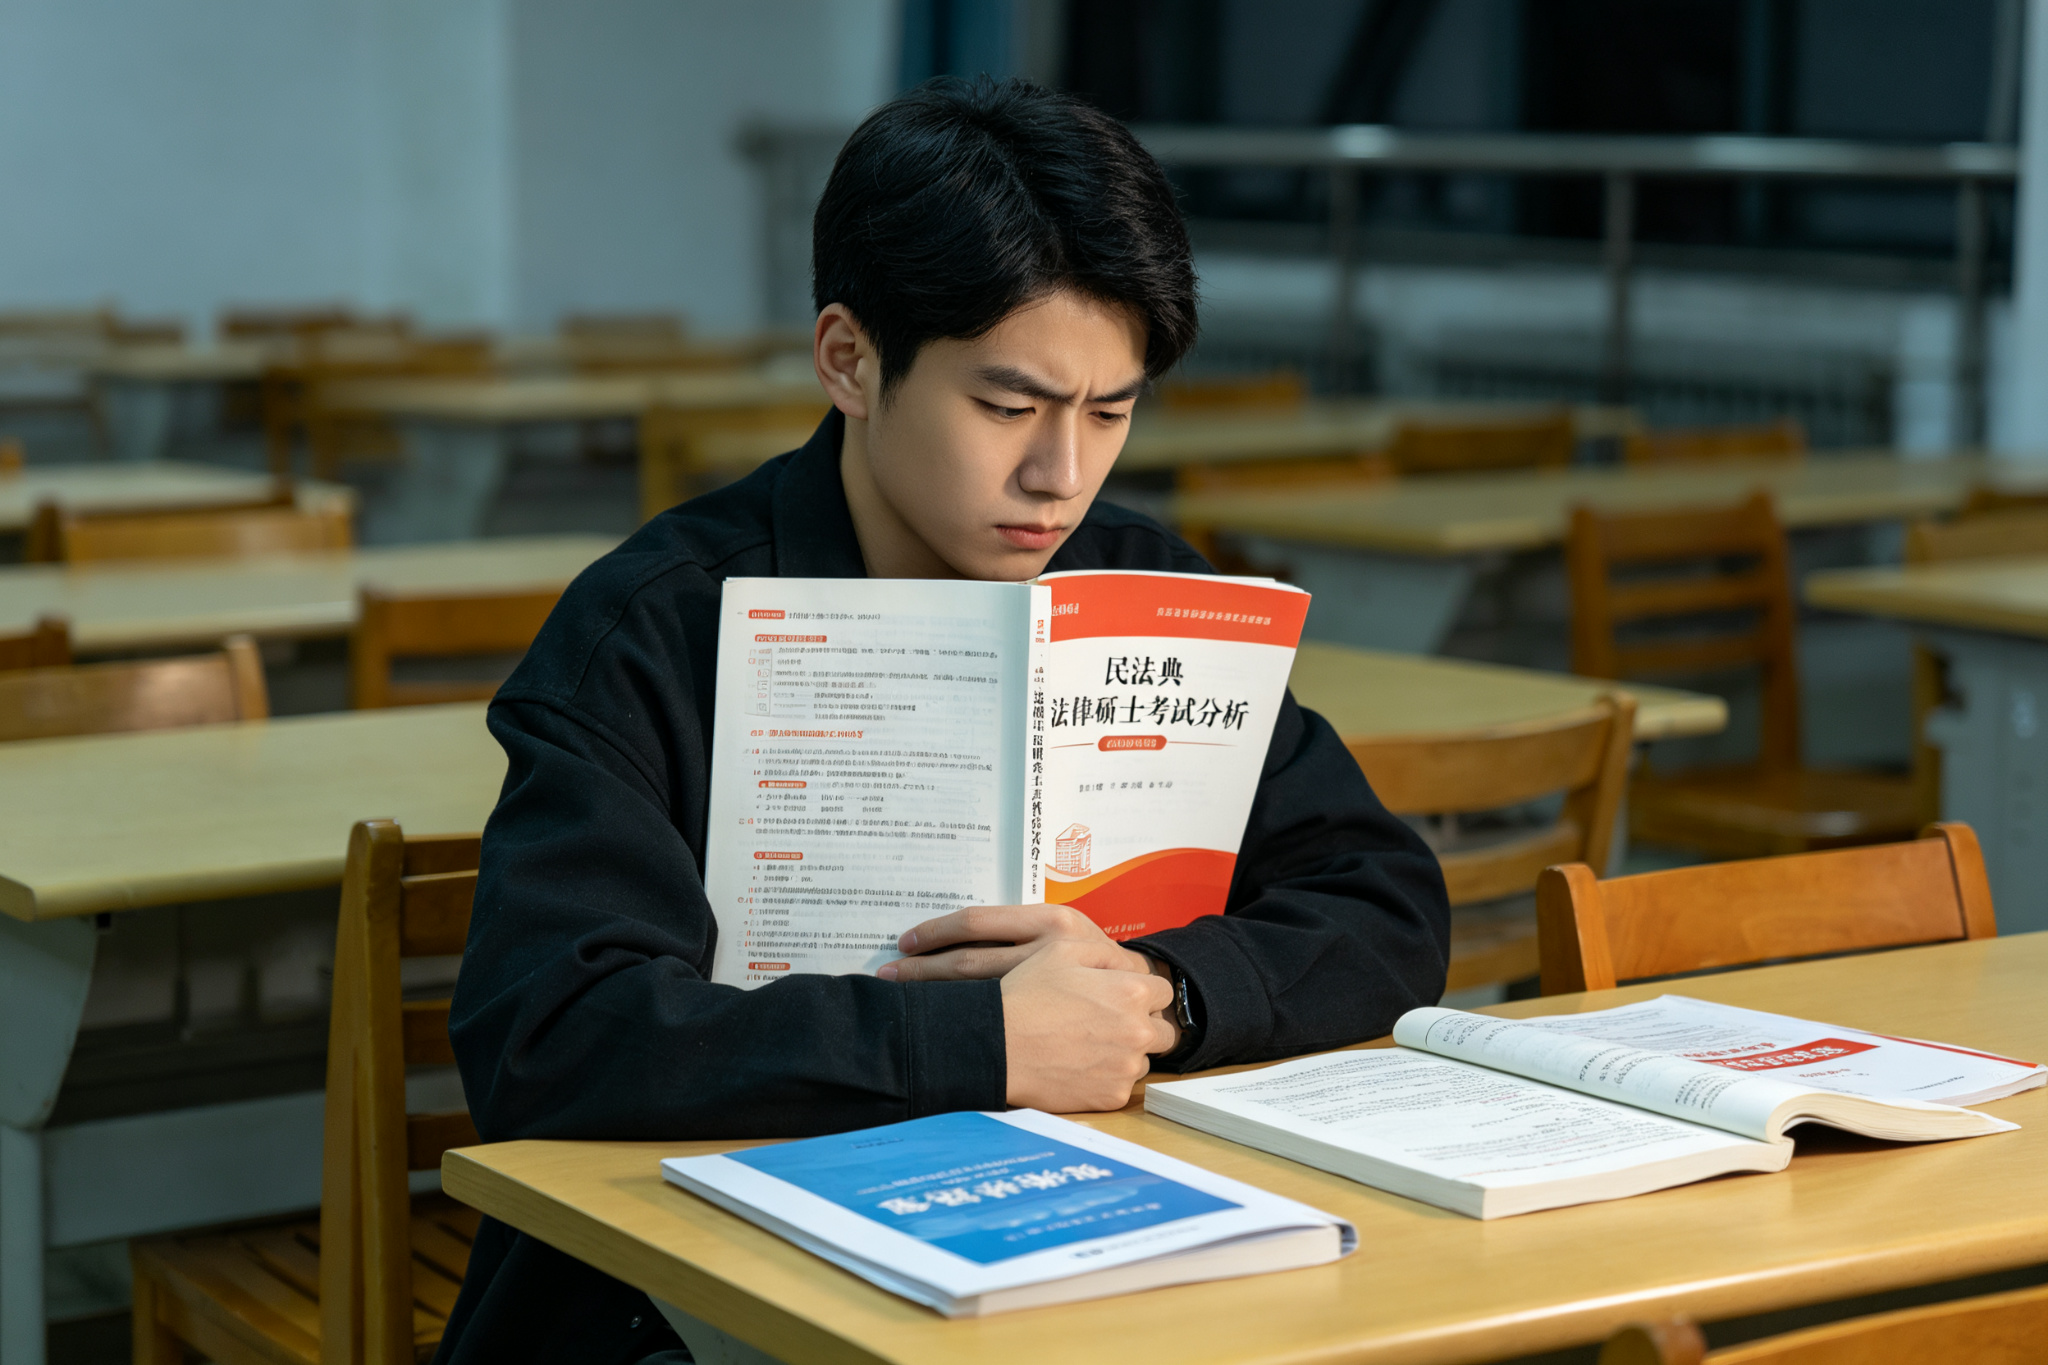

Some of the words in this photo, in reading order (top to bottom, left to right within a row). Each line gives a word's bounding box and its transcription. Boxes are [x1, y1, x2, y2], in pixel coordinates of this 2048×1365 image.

[1105, 656, 1184, 687] 民法典
[1051, 695, 1249, 731] 法律硕士考试分析
